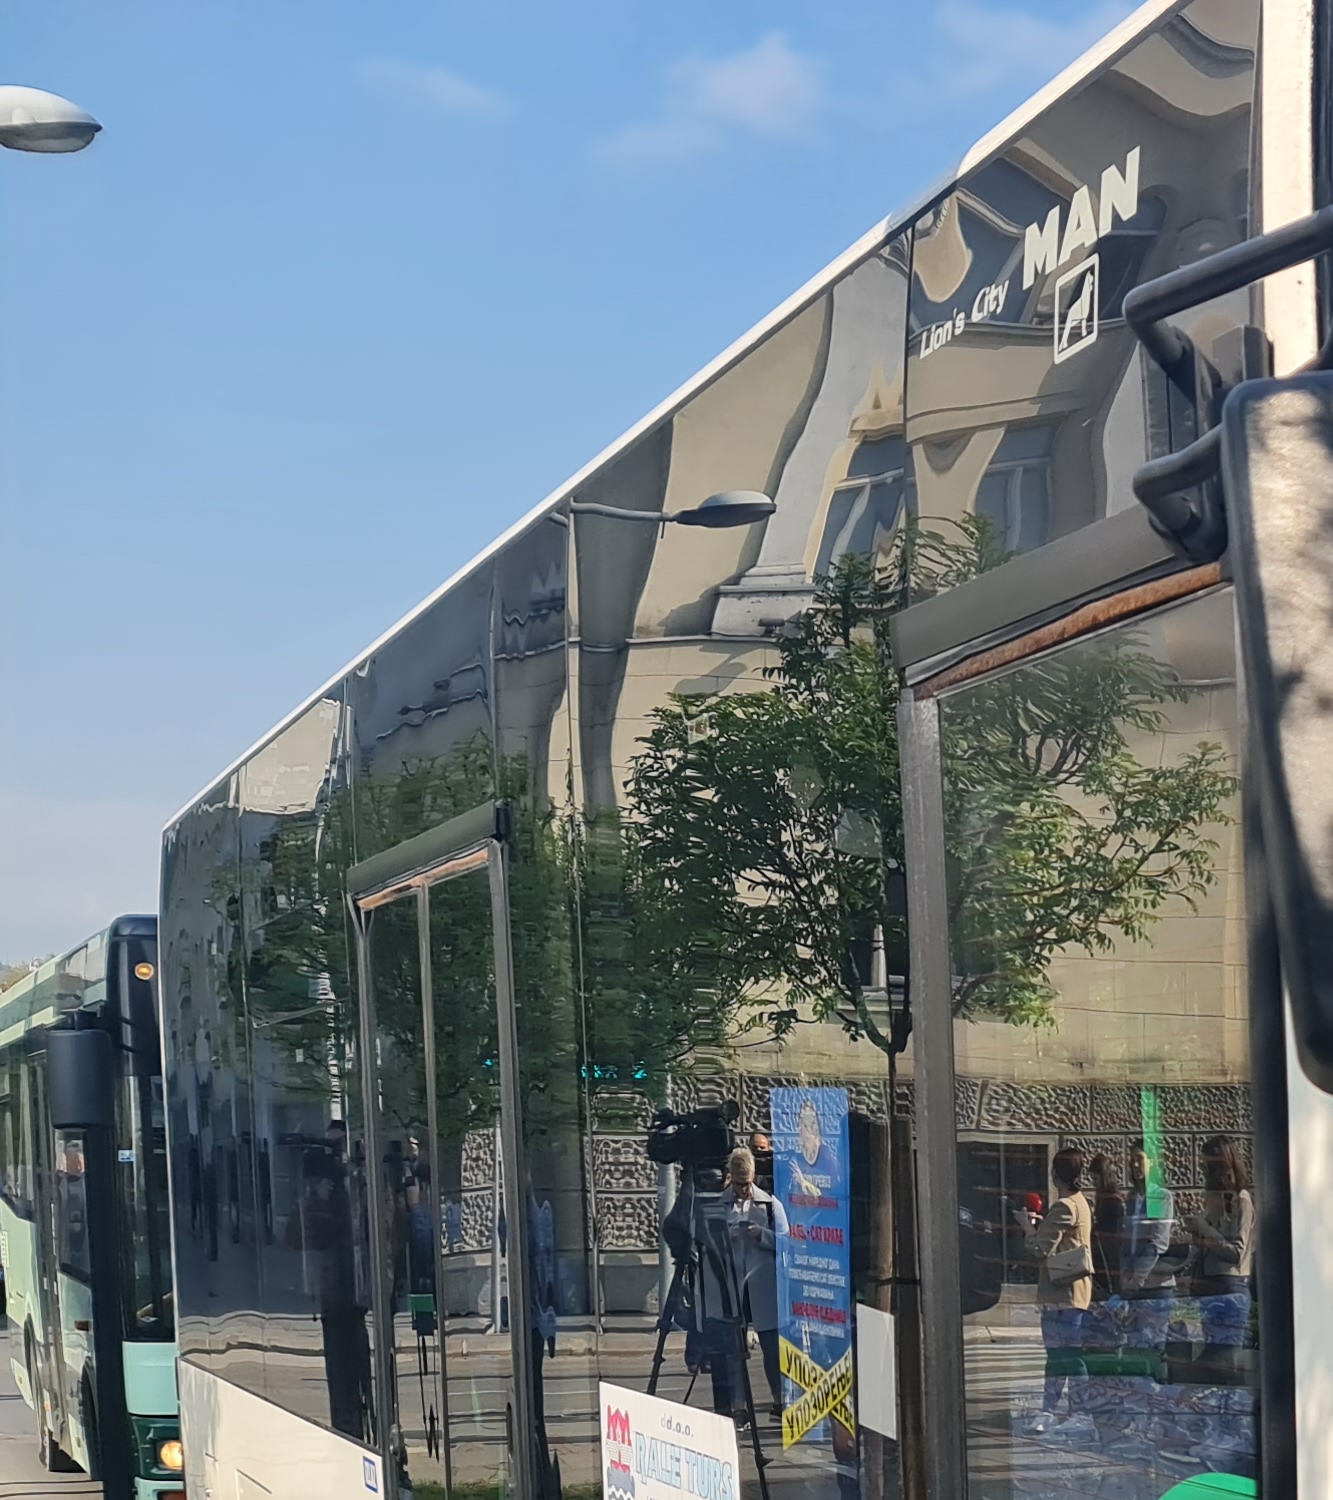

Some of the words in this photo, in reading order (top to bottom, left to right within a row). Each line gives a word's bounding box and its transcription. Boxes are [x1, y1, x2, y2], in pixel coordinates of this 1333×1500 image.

[1023, 146, 1140, 290] MAN
[919, 307, 965, 360] Lion's
[972, 279, 1010, 323] City
[635, 1430, 681, 1489] RALE
